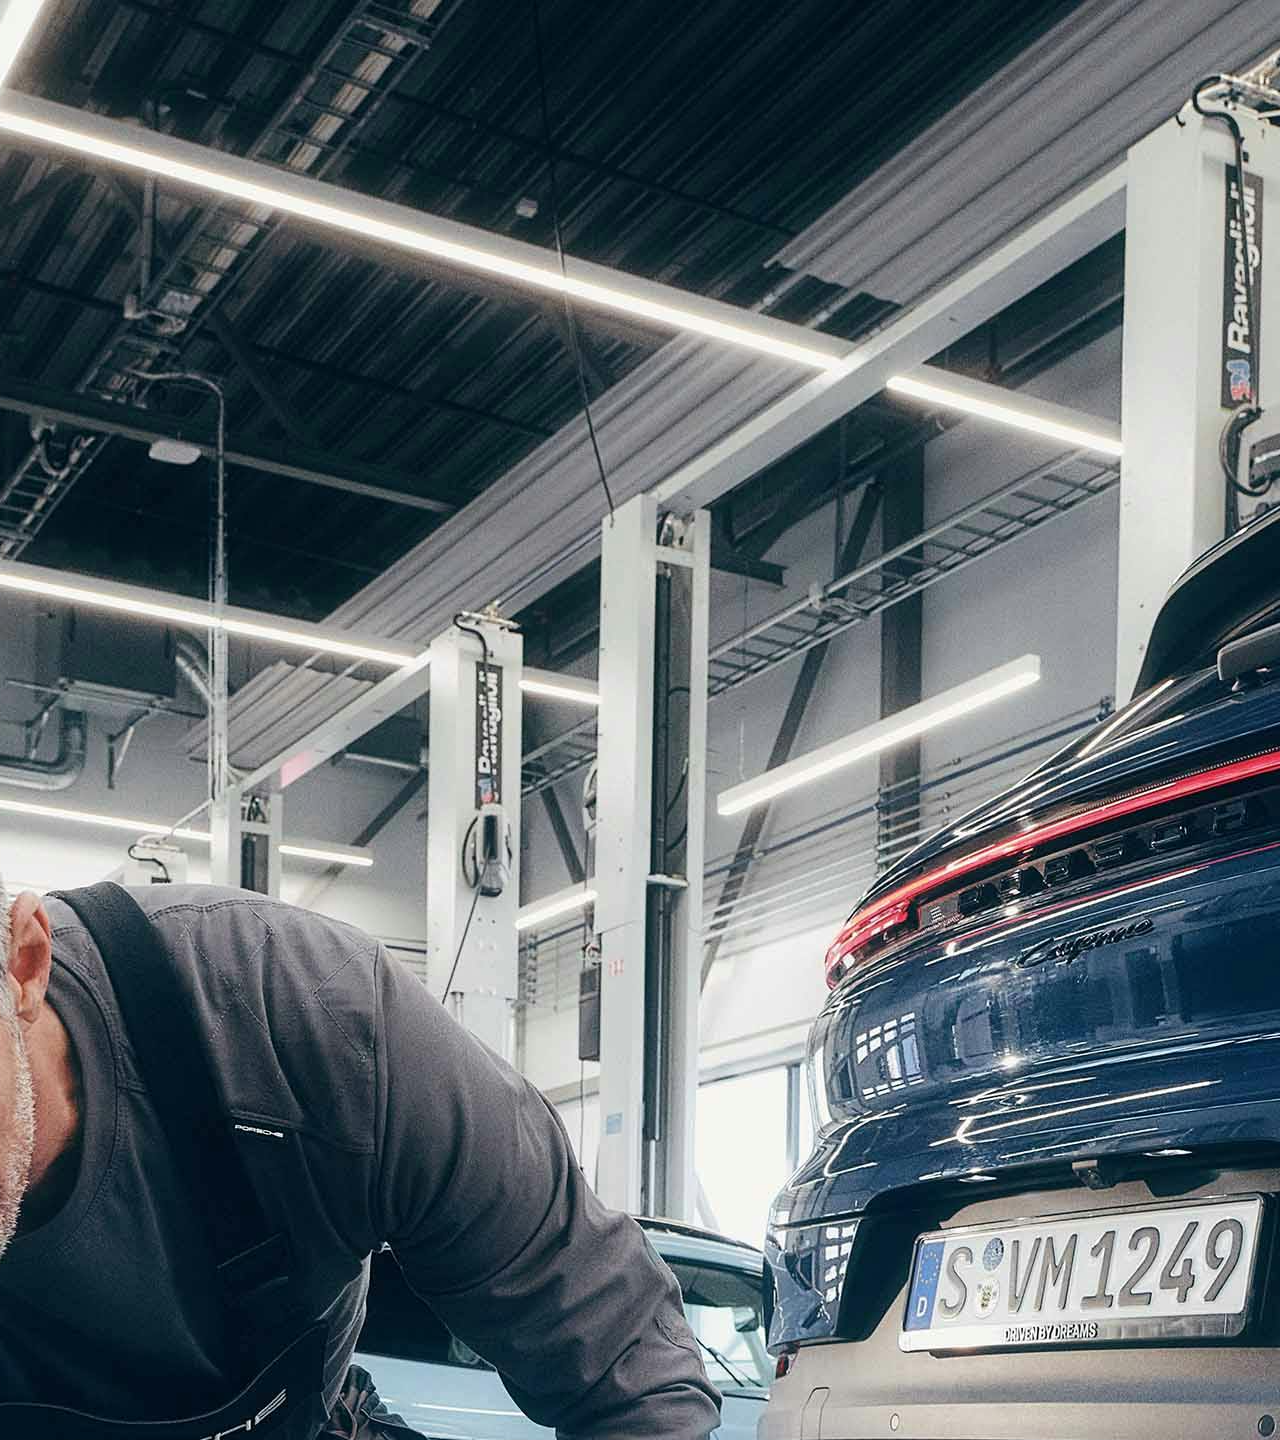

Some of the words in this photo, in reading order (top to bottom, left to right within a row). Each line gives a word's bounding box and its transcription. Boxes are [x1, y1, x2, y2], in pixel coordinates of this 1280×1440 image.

[938, 1246, 974, 1319] S
[1080, 1218, 1244, 1309] 1249
[916, 1297, 927, 1318] D
[1005, 1325, 1039, 1342] DRIVEN
[1038, 1325, 1054, 1340] BY
[1054, 1322, 1099, 1340] DREAMS
